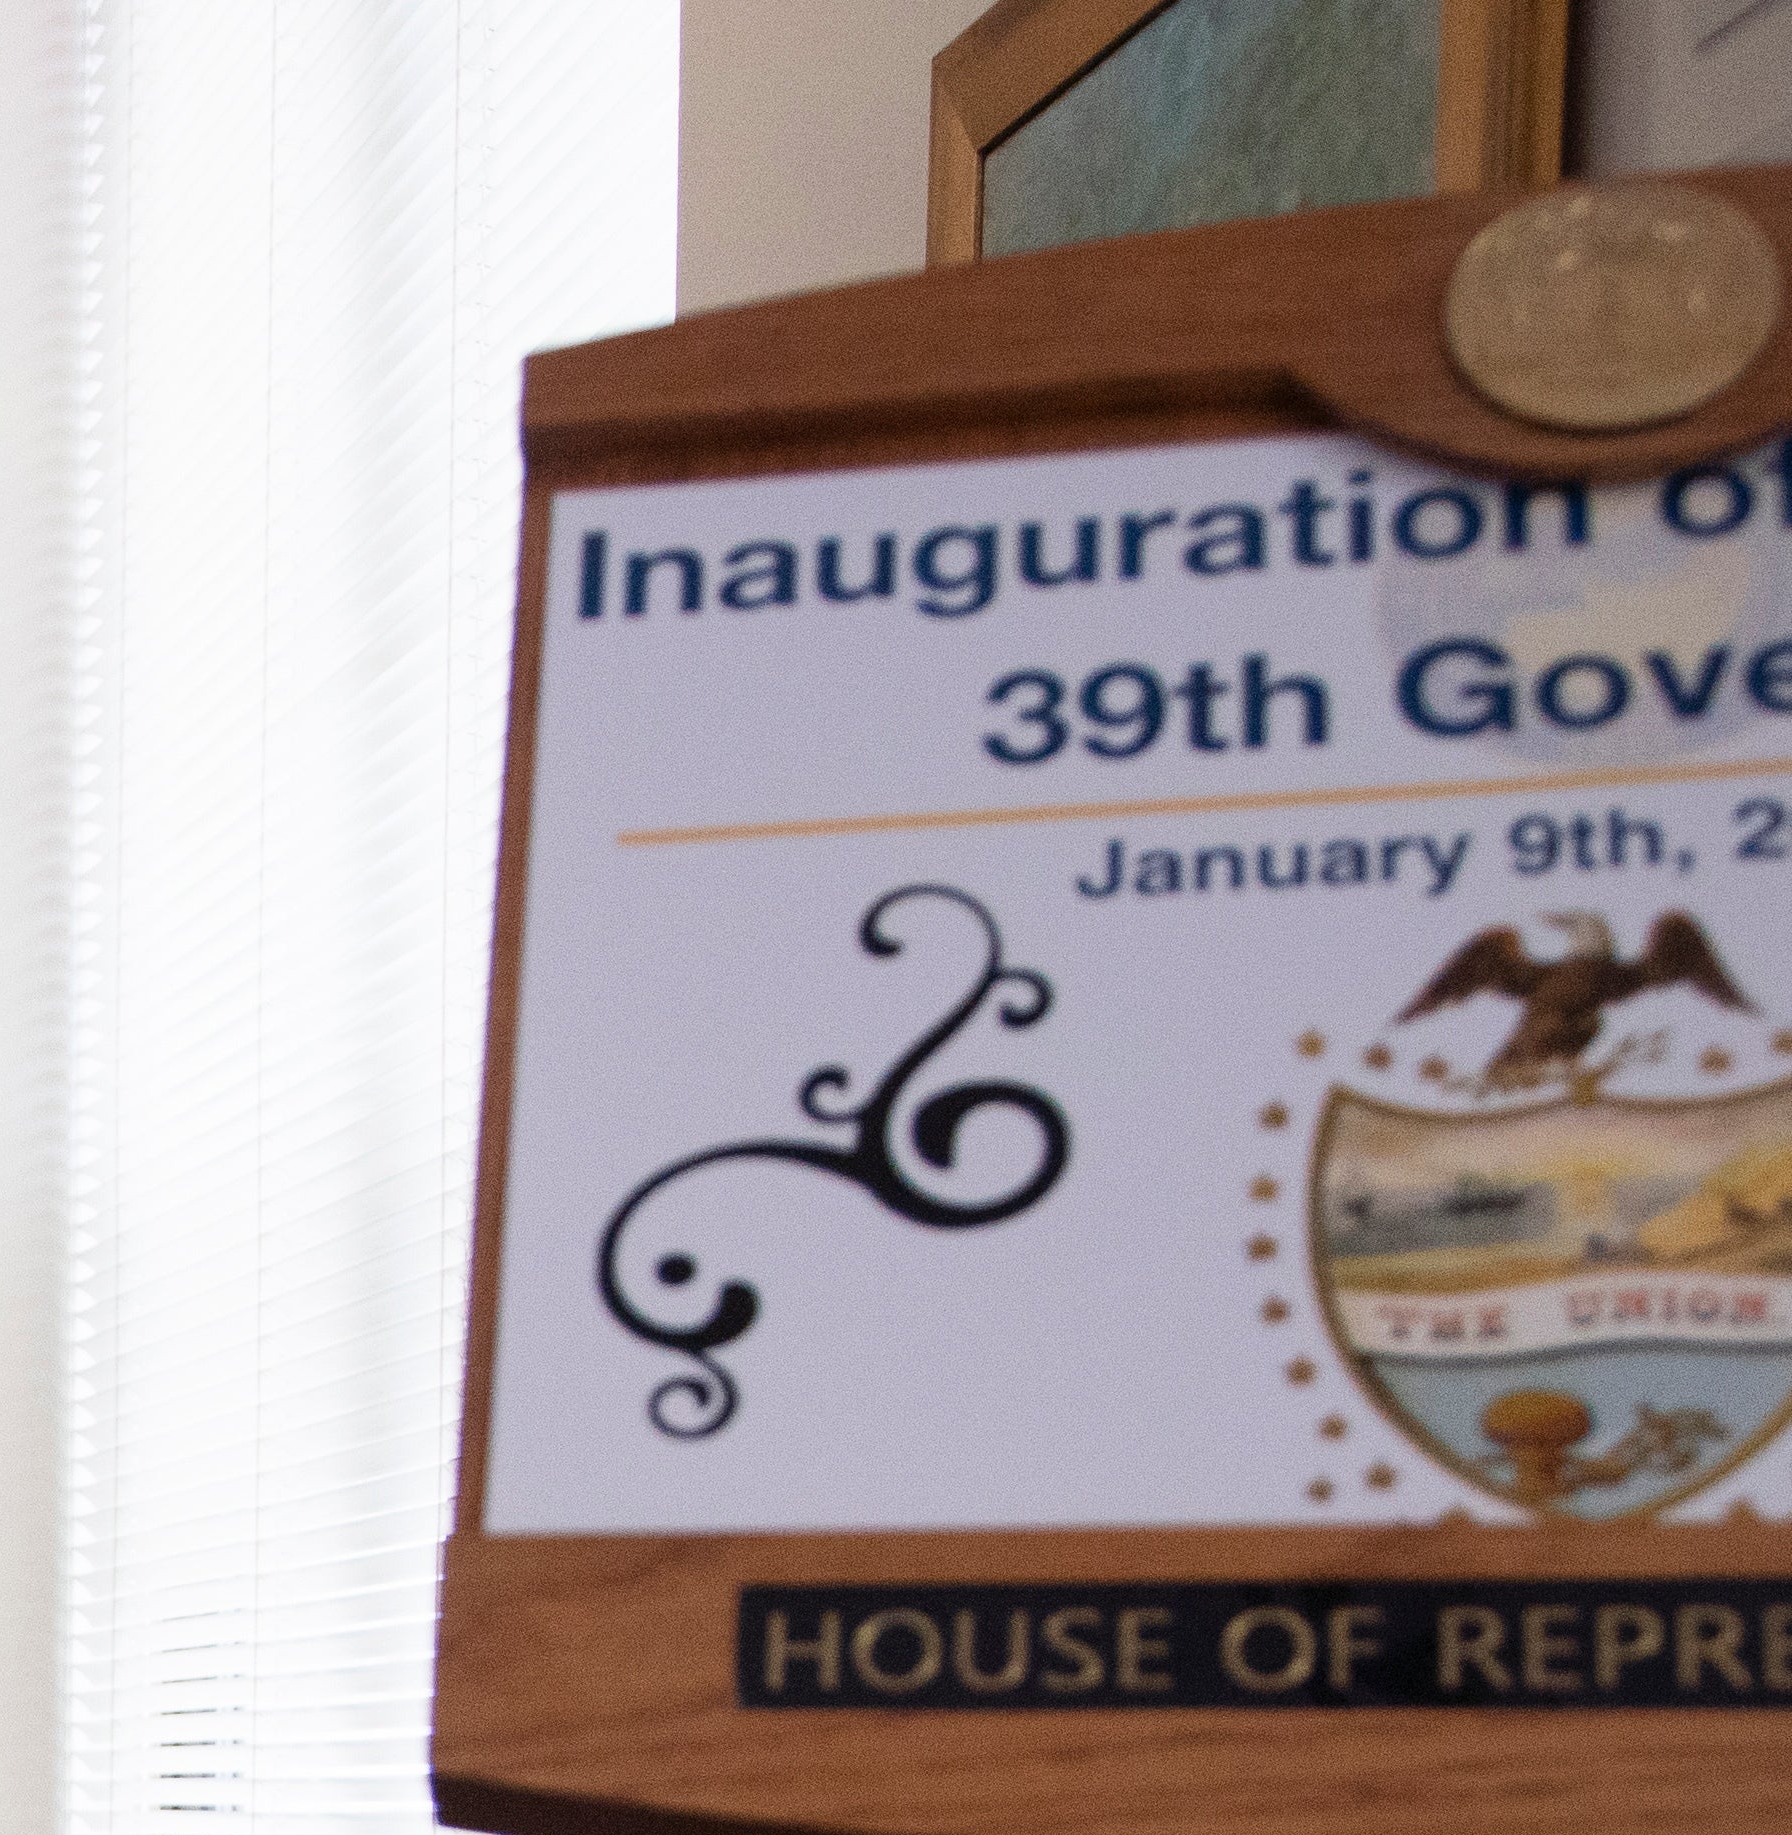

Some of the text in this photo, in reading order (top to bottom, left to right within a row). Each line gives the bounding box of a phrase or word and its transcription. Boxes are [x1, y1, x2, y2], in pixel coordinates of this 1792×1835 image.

[576, 440, 1792, 622] Inauguration o
[982, 652, 1333, 767] 39th
[1075, 828, 1473, 902] January
[1510, 807, 1697, 876] 9th,
[1377, 1304, 1509, 1341] THE
[763, 1605, 1176, 1694] HOUSE
[1221, 1604, 1386, 1692] OF
